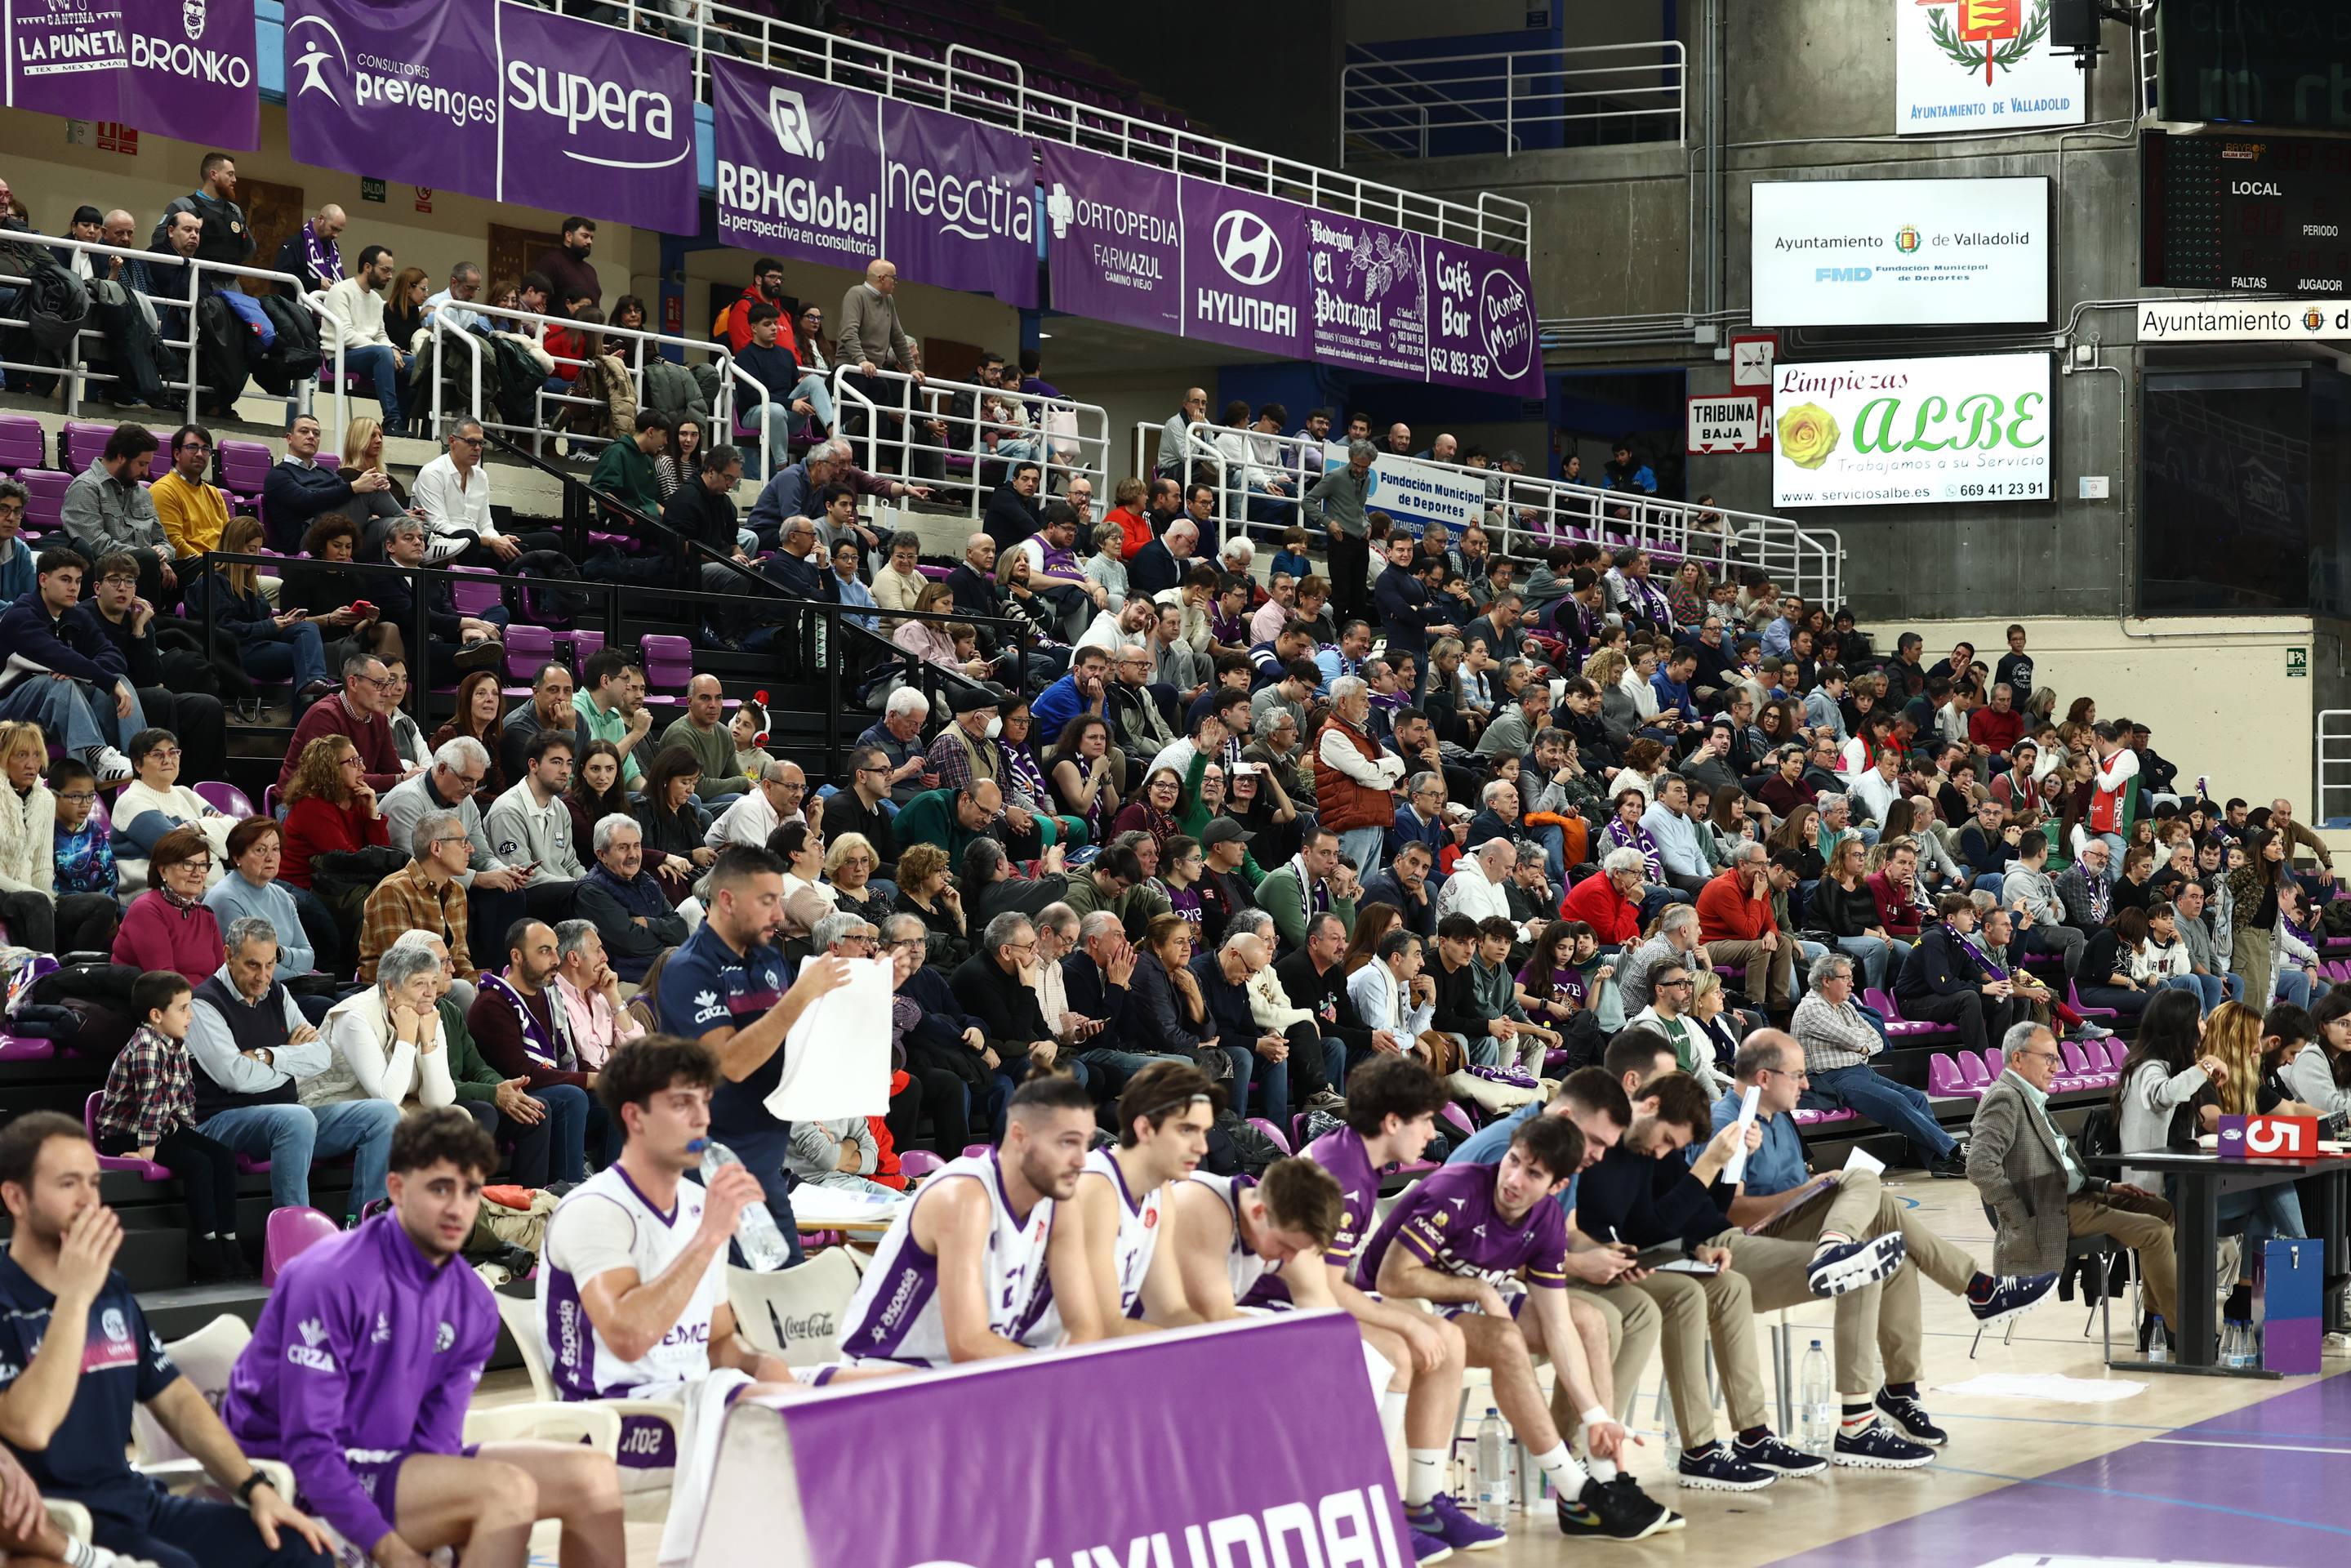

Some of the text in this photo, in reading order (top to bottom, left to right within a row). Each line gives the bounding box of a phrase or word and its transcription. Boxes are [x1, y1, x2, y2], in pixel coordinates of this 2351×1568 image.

[47, 11, 95, 25] CANTINA
[19, 27, 126, 61] LA PUÑETA
[62, 63, 82, 71] MEX
[131, 33, 251, 88] BRONKO
[357, 53, 430, 79] CONSULTORES
[356, 72, 496, 127] prevenges
[507, 60, 673, 140] supera
[1911, 97, 2070, 120] AYUNTAMIENTO DE VALLADOLID
[363, 181, 384, 195] SALIDA
[718, 159, 876, 237] RBHGlobal
[2232, 181, 2282, 197] LOCAL
[719, 207, 876, 257] La perspectiva en consultoría
[1076, 199, 1178, 247] ORTOPEDIA
[1310, 219, 1354, 252] Bodegón
[2303, 225, 2339, 237] PERIODO
[1774, 232, 2029, 250] Ayuntamiento de Valladolid
[1093, 243, 1163, 280] FARMAZUL
[1313, 250, 1334, 284] El
[1814, 266, 1872, 283] FMD
[1934, 263, 1988, 272] Municipal
[1105, 271, 1152, 291] CAMINO VIEJO
[1436, 251, 1473, 302] Café
[1914, 274, 1970, 283] Deportes
[2232, 277, 2267, 289] FALTAS
[2298, 278, 2343, 291] JUGADOR
[1198, 287, 1297, 337] HYUNDAI
[1314, 287, 1382, 336] Pedragal
[1487, 284, 1524, 323] Donde
[1441, 296, 1472, 339] Bar
[2143, 310, 2291, 340] Ayuntamiento
[1354, 337, 1360, 347] DE
[1431, 347, 1489, 379] 652 893 352
[1779, 368, 1908, 399] Limpiezas
[1694, 403, 1755, 424] TRIBUNA
[1852, 392, 2045, 454] ALBE
[1702, 427, 1743, 439] BAJA
[1837, 459, 1931, 474] Trabajamos
[1952, 459, 1970, 469] su
[1976, 454, 2045, 469] Servicio
[1380, 471, 1432, 492] Fundación
[1435, 483, 1484, 506] Municipal
[1781, 486, 1930, 503] www. serviciosalbe.es
[1960, 482, 2044, 497] 669 41 23 91
[1398, 493, 1464, 518] de Deportes
[501, 843, 515, 853] JOE
[2246, 1119, 2300, 1153] 5
[287, 1344, 336, 1373] CRZA
